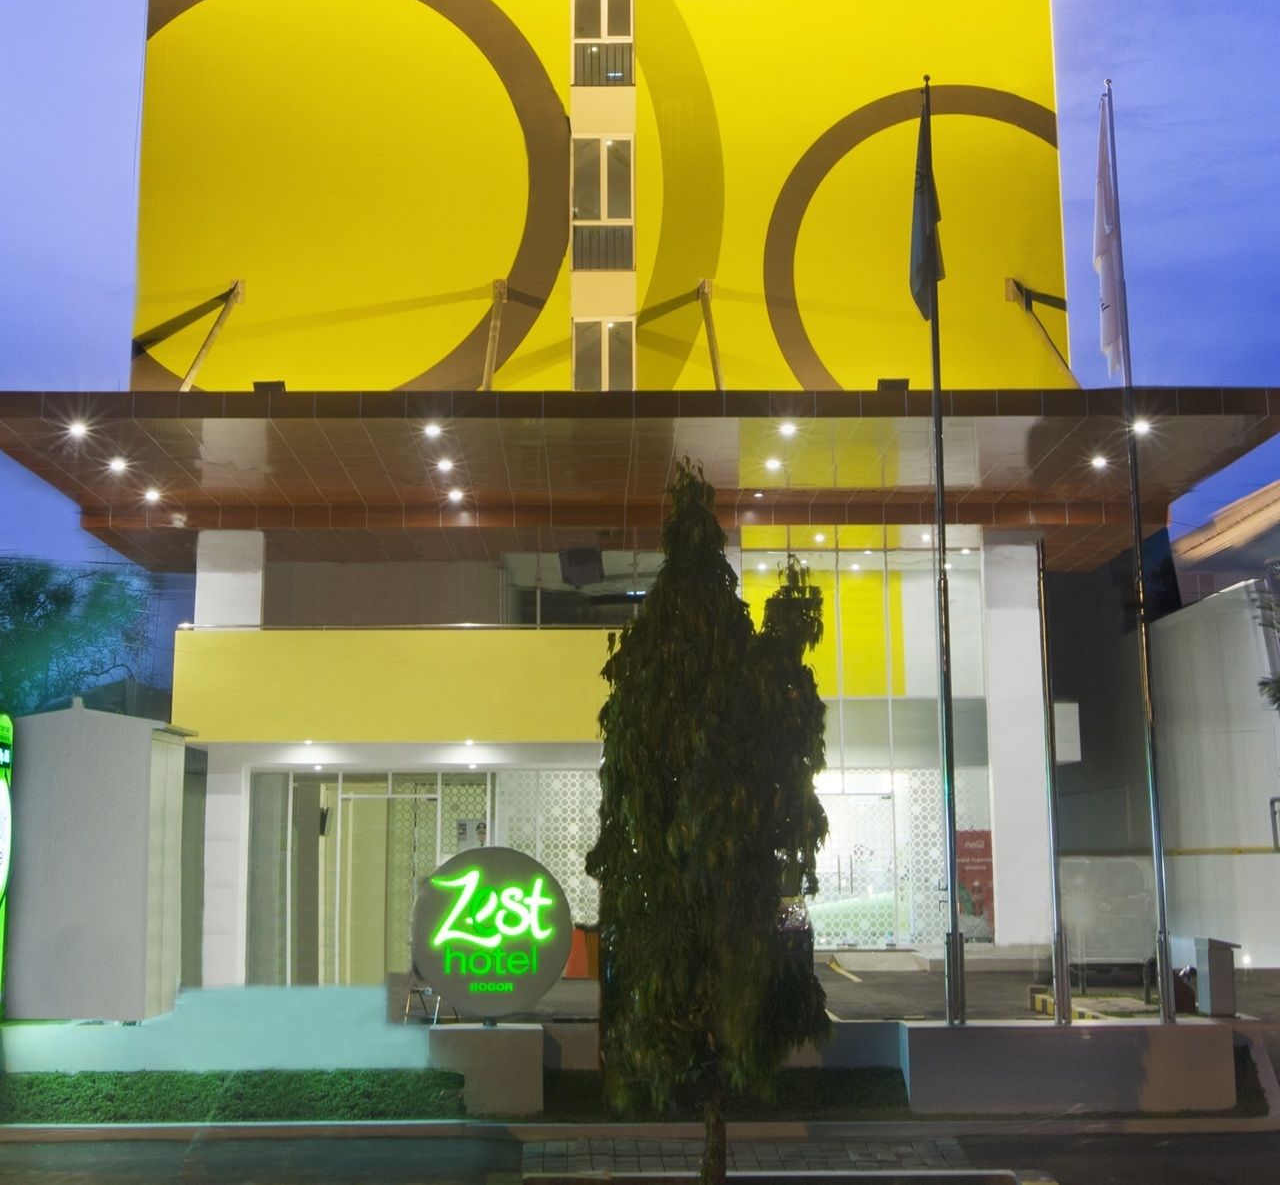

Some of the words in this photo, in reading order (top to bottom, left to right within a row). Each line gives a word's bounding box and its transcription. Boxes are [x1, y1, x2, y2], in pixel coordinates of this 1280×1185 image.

[431, 869, 554, 948] Zest
[443, 944, 539, 976] hotel
[469, 982, 514, 992] BOGOR
